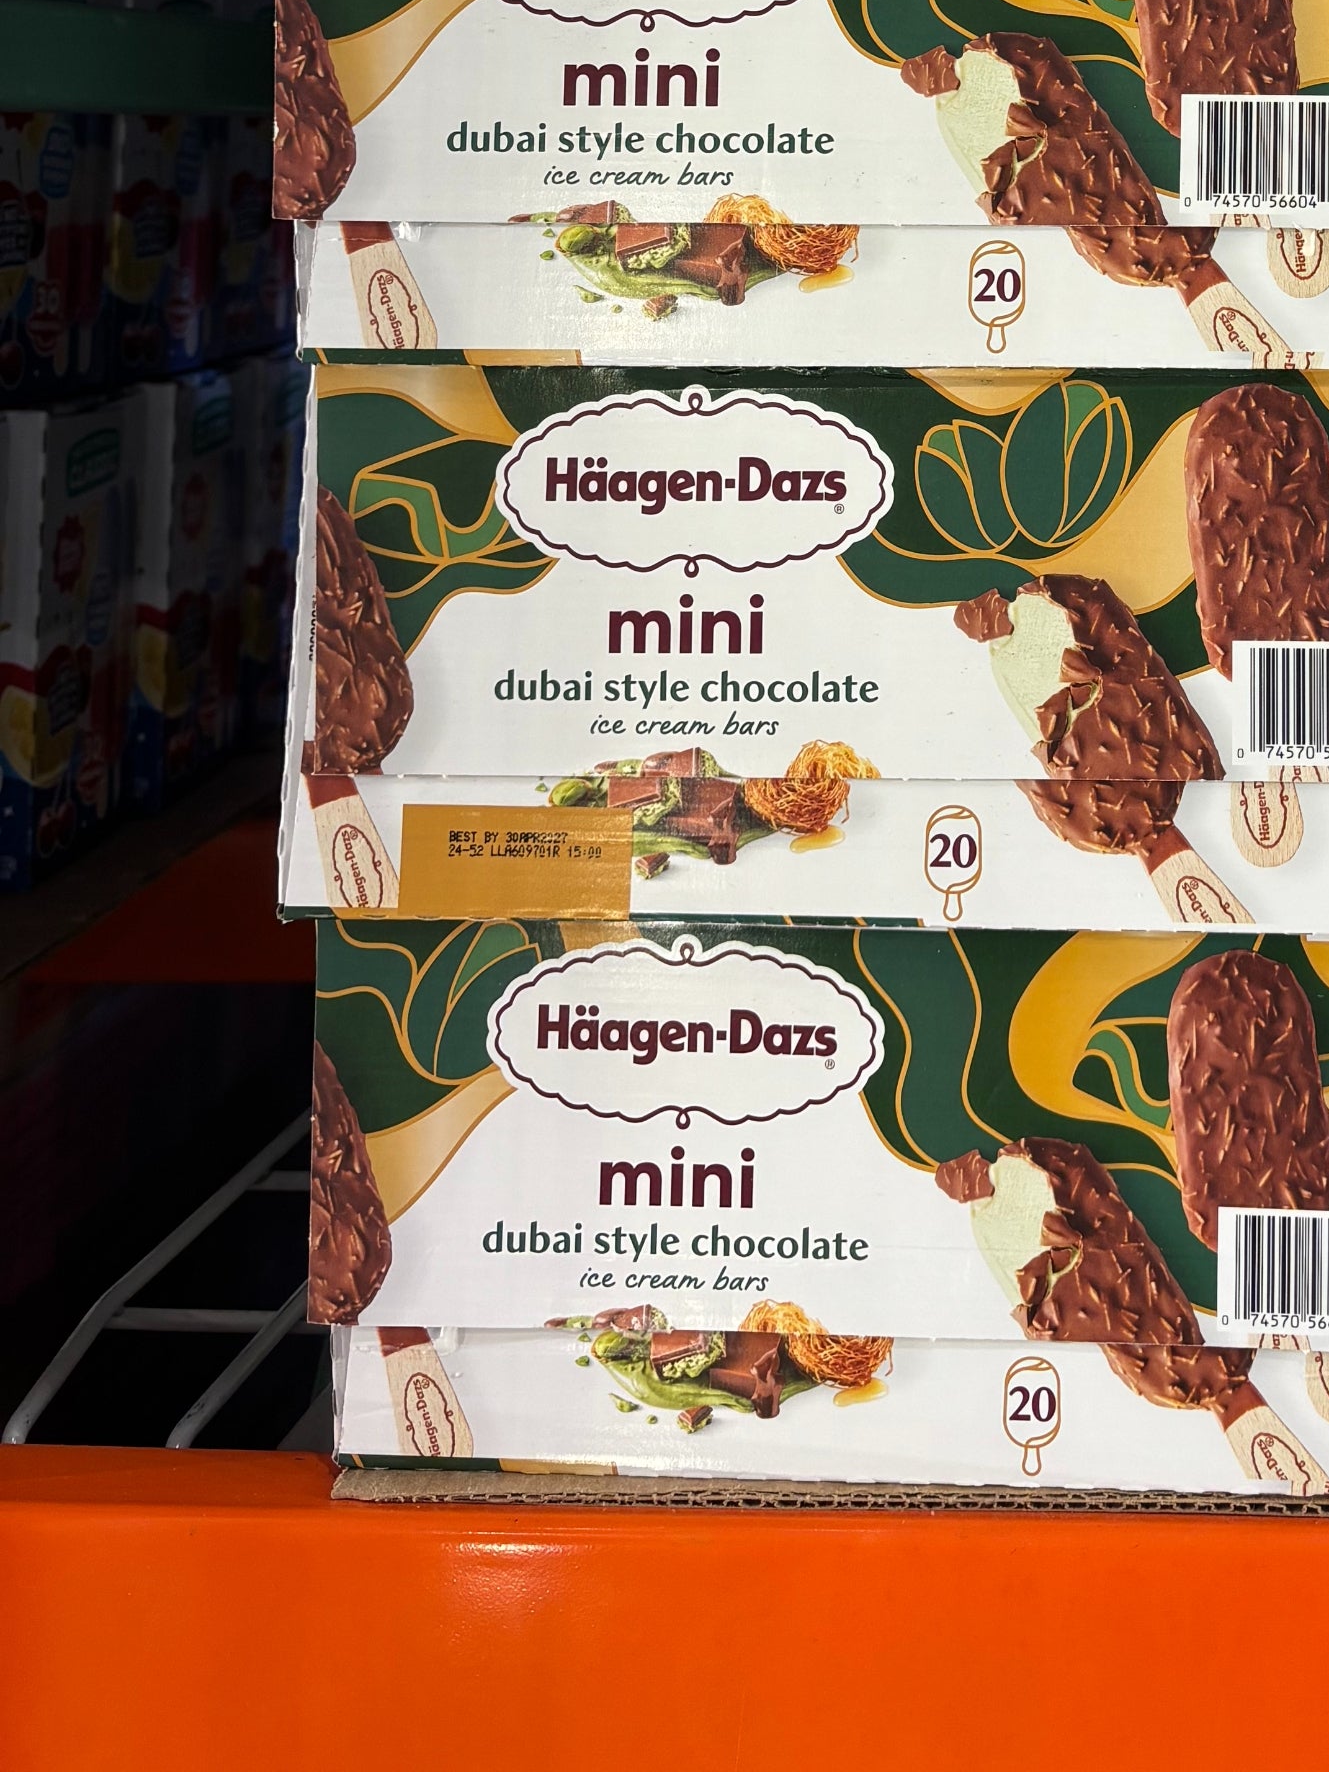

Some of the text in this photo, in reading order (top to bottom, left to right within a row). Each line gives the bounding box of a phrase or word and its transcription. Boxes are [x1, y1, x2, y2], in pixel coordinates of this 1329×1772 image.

[563, 48, 720, 106] mini
[447, 121, 834, 160] dubai style chocolate
[544, 162, 734, 185] ice cream bars
[1213, 194, 1317, 208] 74570 56604
[974, 269, 1021, 302] 20
[546, 457, 847, 515] Häagen-Dazs
[609, 594, 764, 654] mini
[495, 669, 879, 709] dubai style chocolate
[590, 711, 779, 735] ice cream bars
[1266, 746, 1315, 759] 74570
[448, 844, 484, 857] 24-52
[449, 830, 477, 843] BEST
[484, 831, 499, 843] BY
[930, 834, 977, 868] 20
[537, 1004, 837, 1064] Häagen-Dazs
[599, 1146, 755, 1208] mini
[483, 1221, 868, 1262] dubai style chocolate
[580, 1266, 769, 1291] ice cream bars
[1251, 1313, 1299, 1327] 74570
[1009, 1386, 1056, 1422] 20
